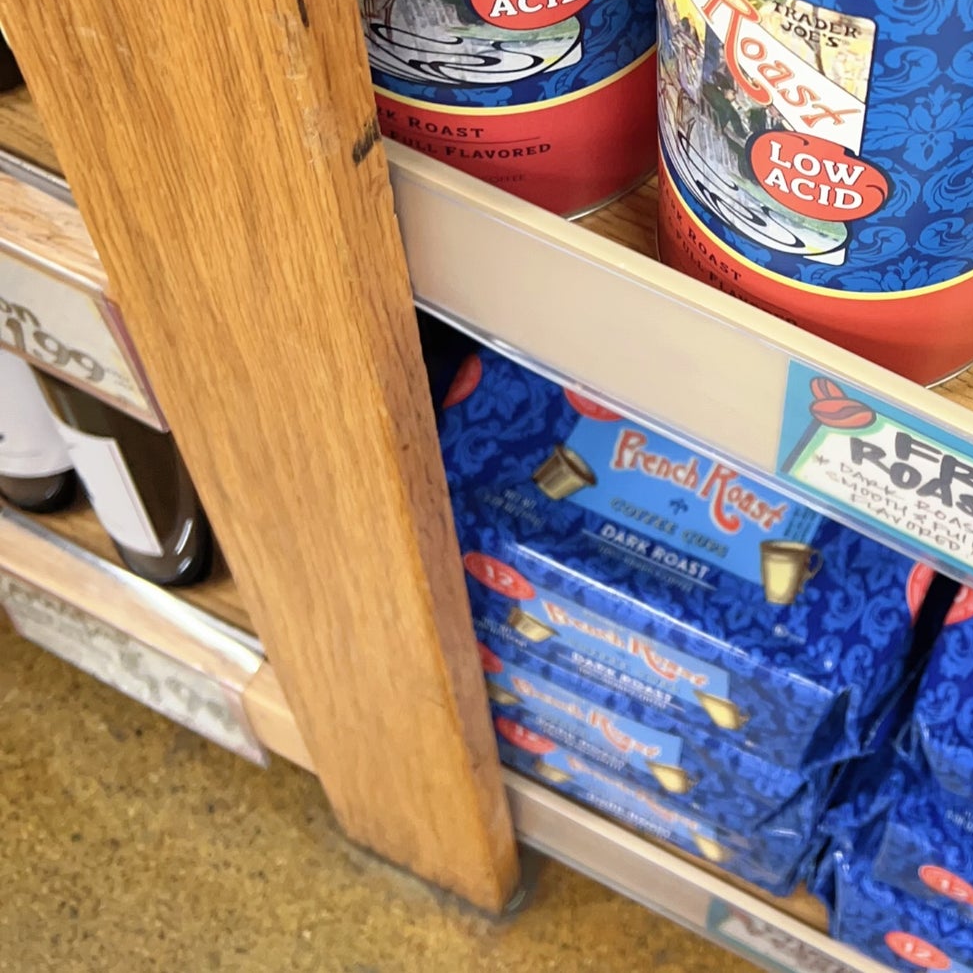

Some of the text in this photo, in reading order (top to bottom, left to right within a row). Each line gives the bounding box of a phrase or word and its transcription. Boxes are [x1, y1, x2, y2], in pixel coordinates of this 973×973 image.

[772, 1, 859, 39] TRADER
[780, 22, 842, 49] JOE'S
[408, 115, 485, 139] ROAST
[446, 143, 551, 160] FLAVORED
[769, 140, 865, 186] LOW
[764, 168, 863, 210] ACID
[688, 227, 742, 282] ROAST
[610, 428, 789, 535] French Roast
[602, 523, 648, 557] DARK
[651, 544, 711, 580] ROAST
